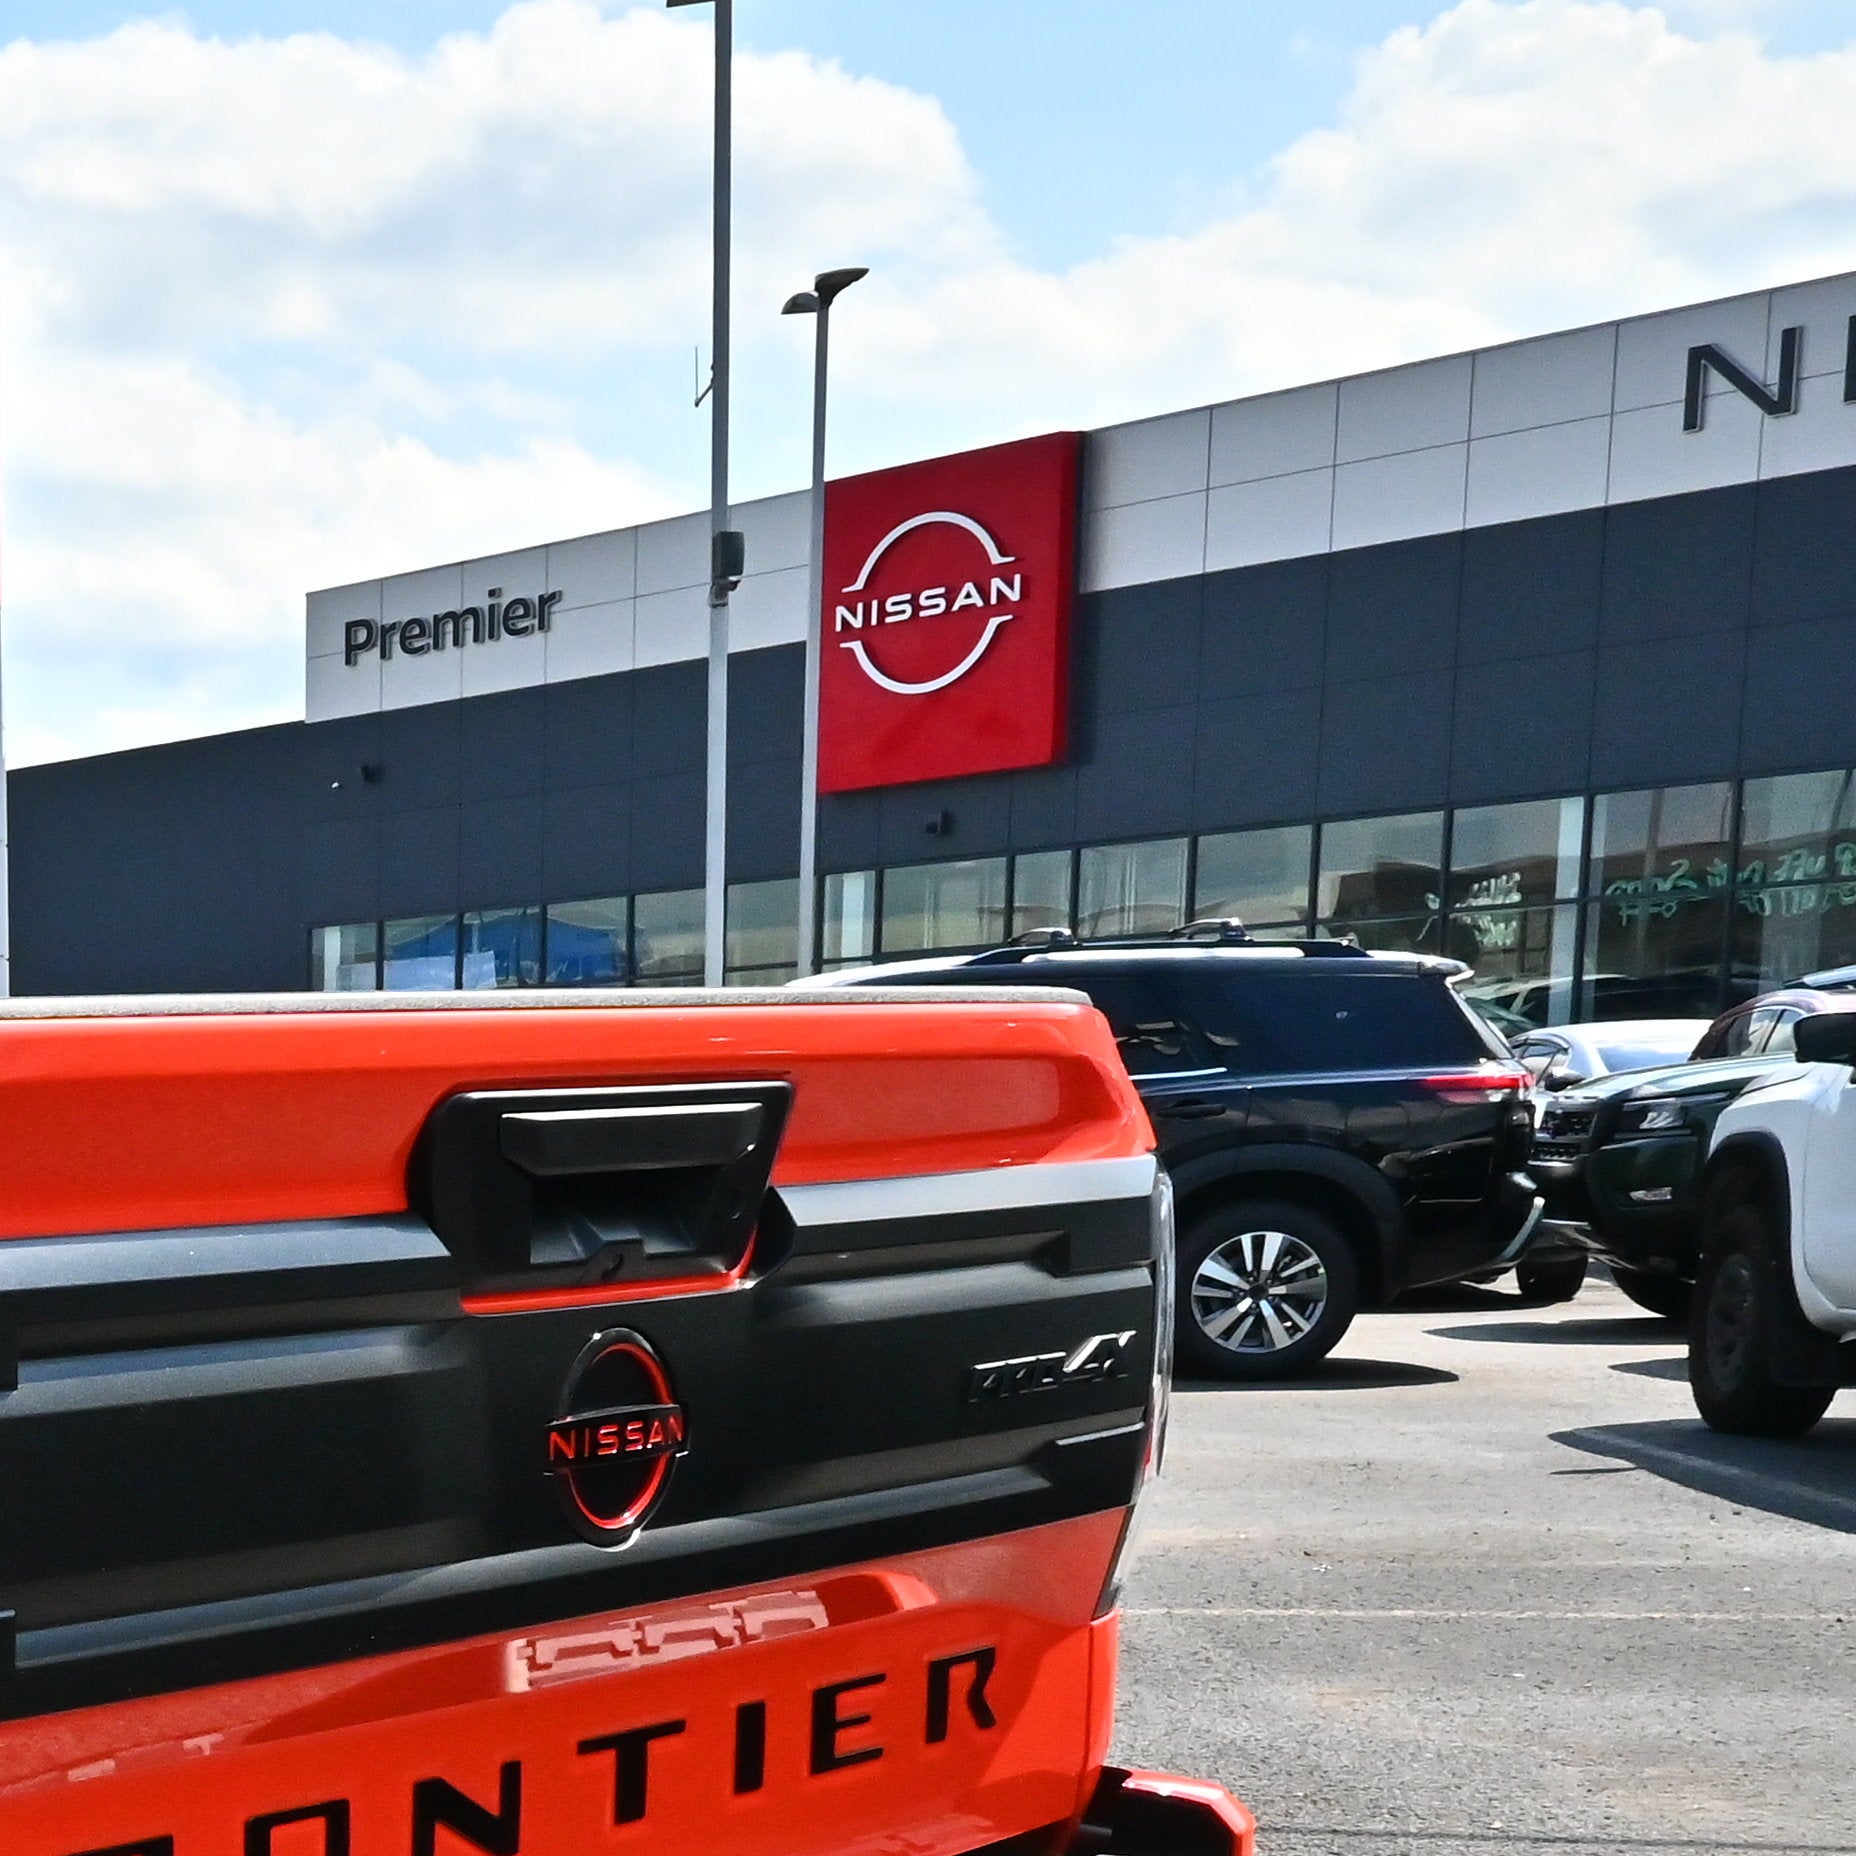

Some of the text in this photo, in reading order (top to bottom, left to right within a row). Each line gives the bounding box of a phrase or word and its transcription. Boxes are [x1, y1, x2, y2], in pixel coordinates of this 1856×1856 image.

[343, 587, 561, 667] Premier
[834, 571, 1023, 633] NISSAN
[547, 1413, 686, 1463] NISSAN
